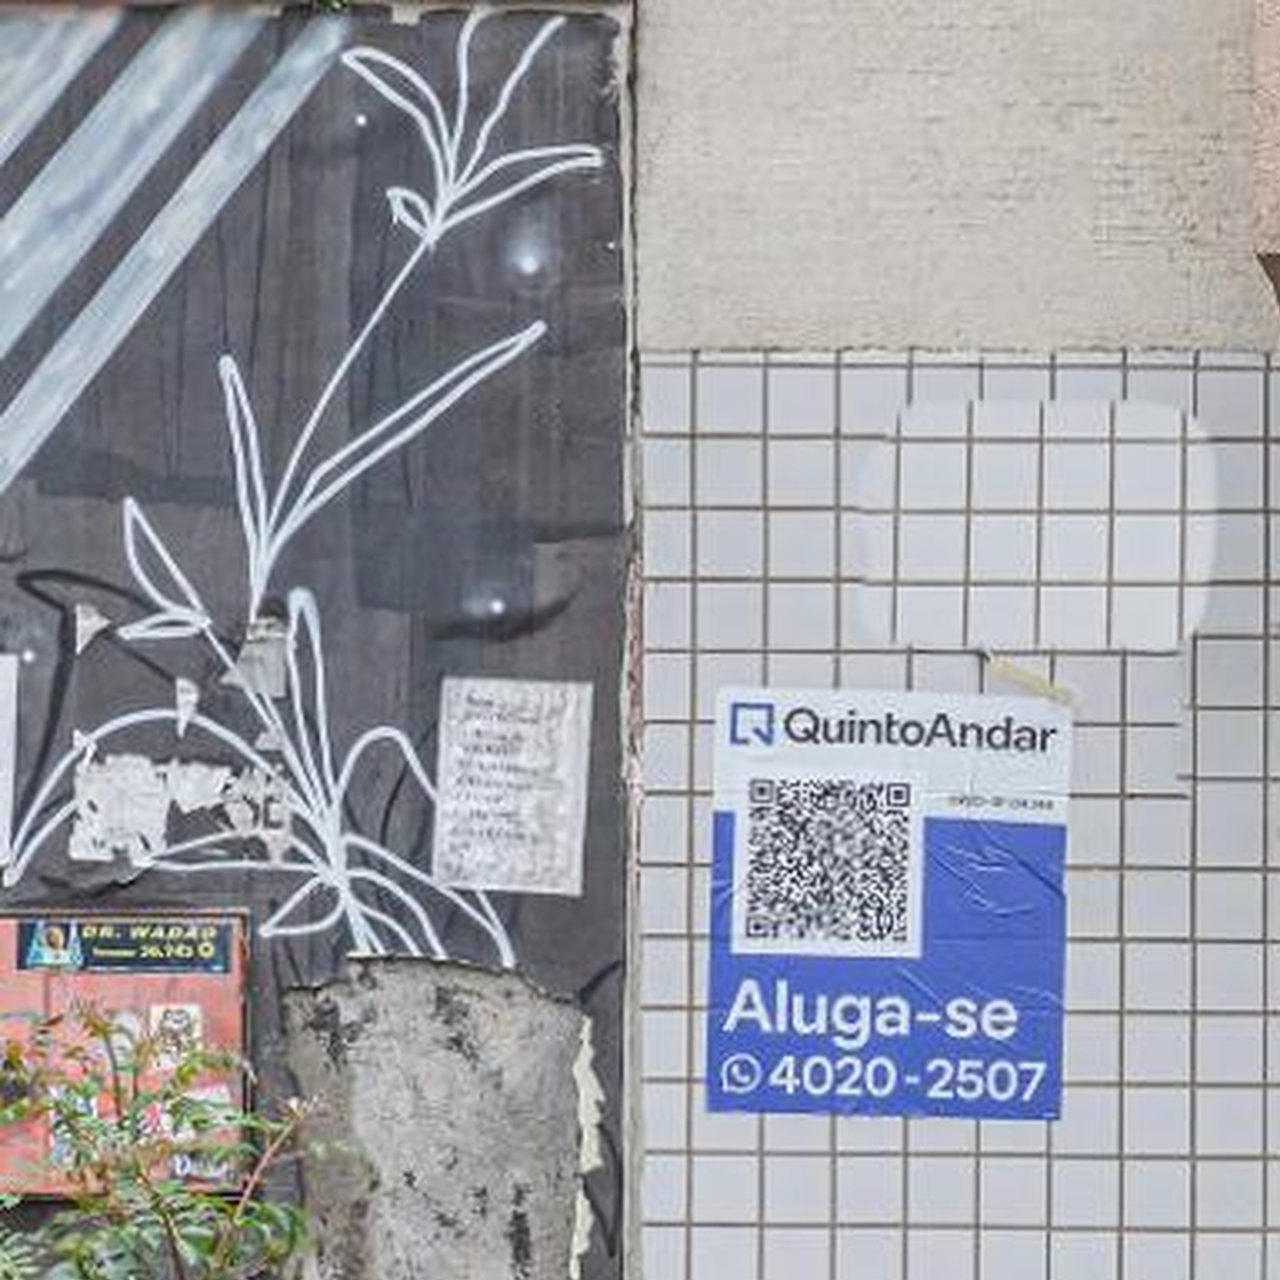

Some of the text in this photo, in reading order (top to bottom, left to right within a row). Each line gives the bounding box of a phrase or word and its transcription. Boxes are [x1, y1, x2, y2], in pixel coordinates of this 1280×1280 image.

[783, 707, 1057, 752] QuintoAndar
[722, 978, 1019, 1049] Aluga-se
[769, 1055, 1047, 1102] 4020-2507
